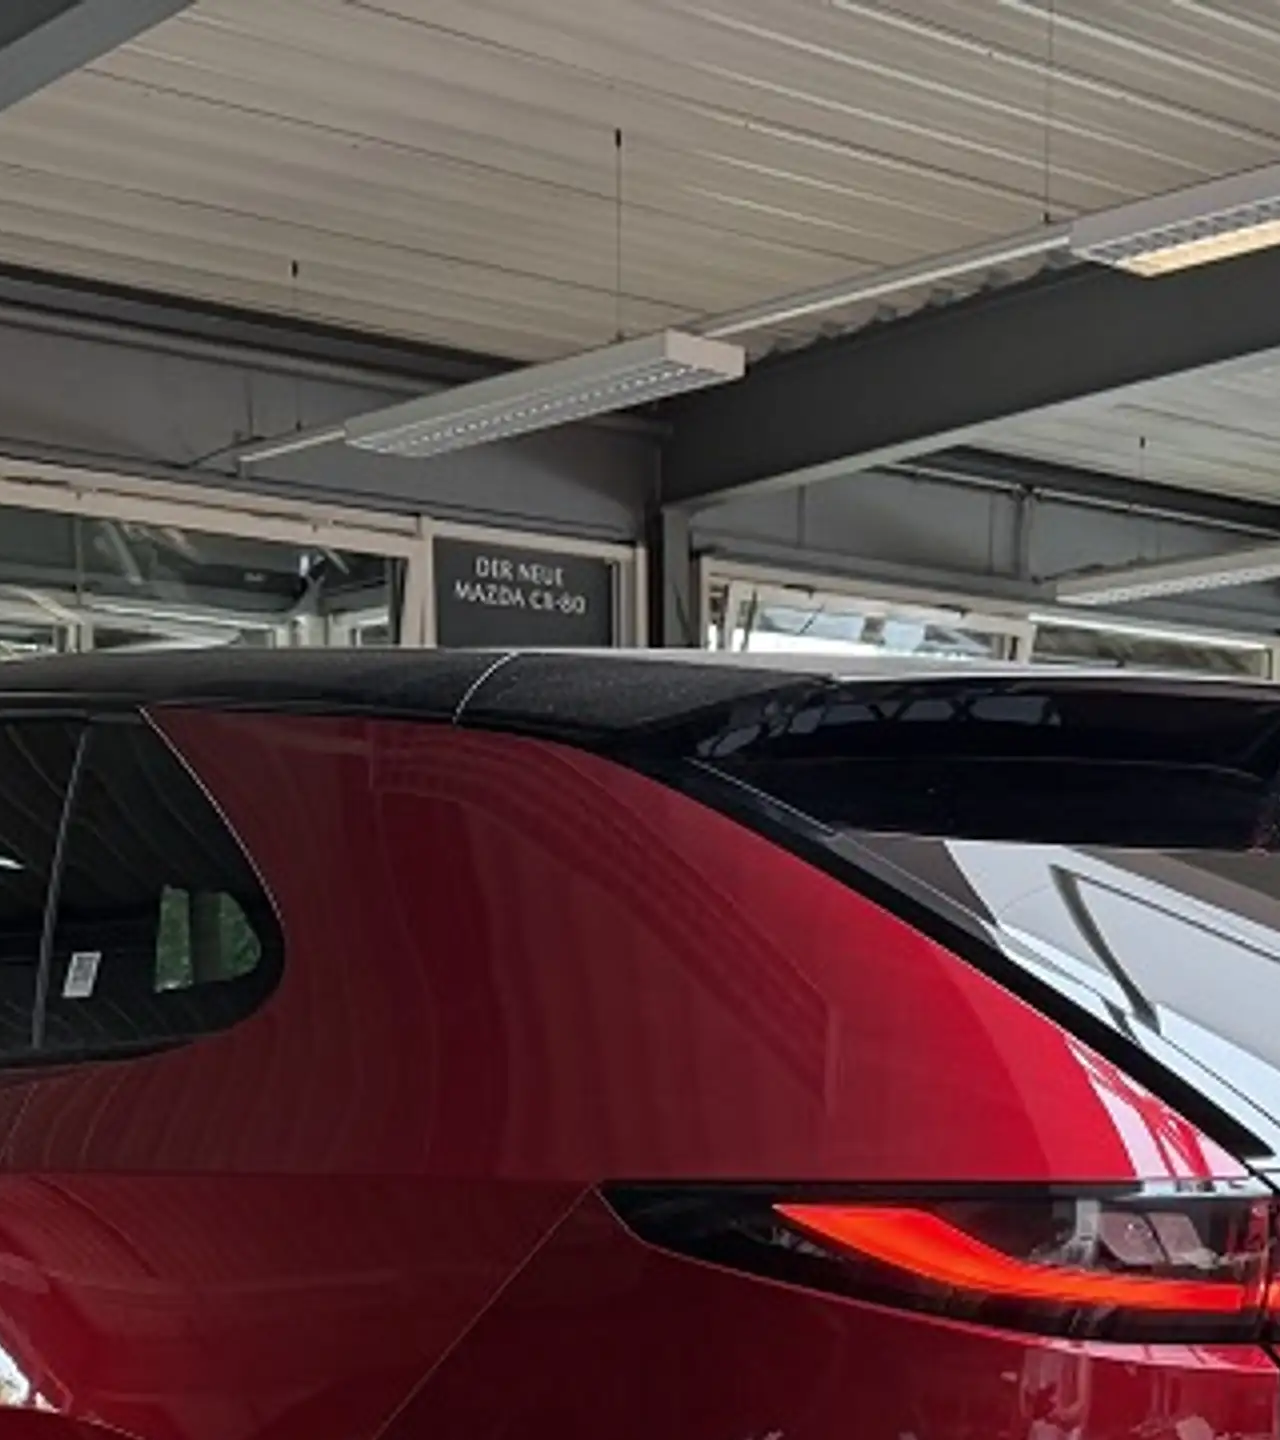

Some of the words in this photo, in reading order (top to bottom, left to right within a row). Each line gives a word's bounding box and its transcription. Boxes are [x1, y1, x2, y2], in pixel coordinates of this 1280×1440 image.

[475, 556, 513, 580] DER
[519, 563, 564, 587] NEUE
[454, 579, 526, 608] MAZDA
